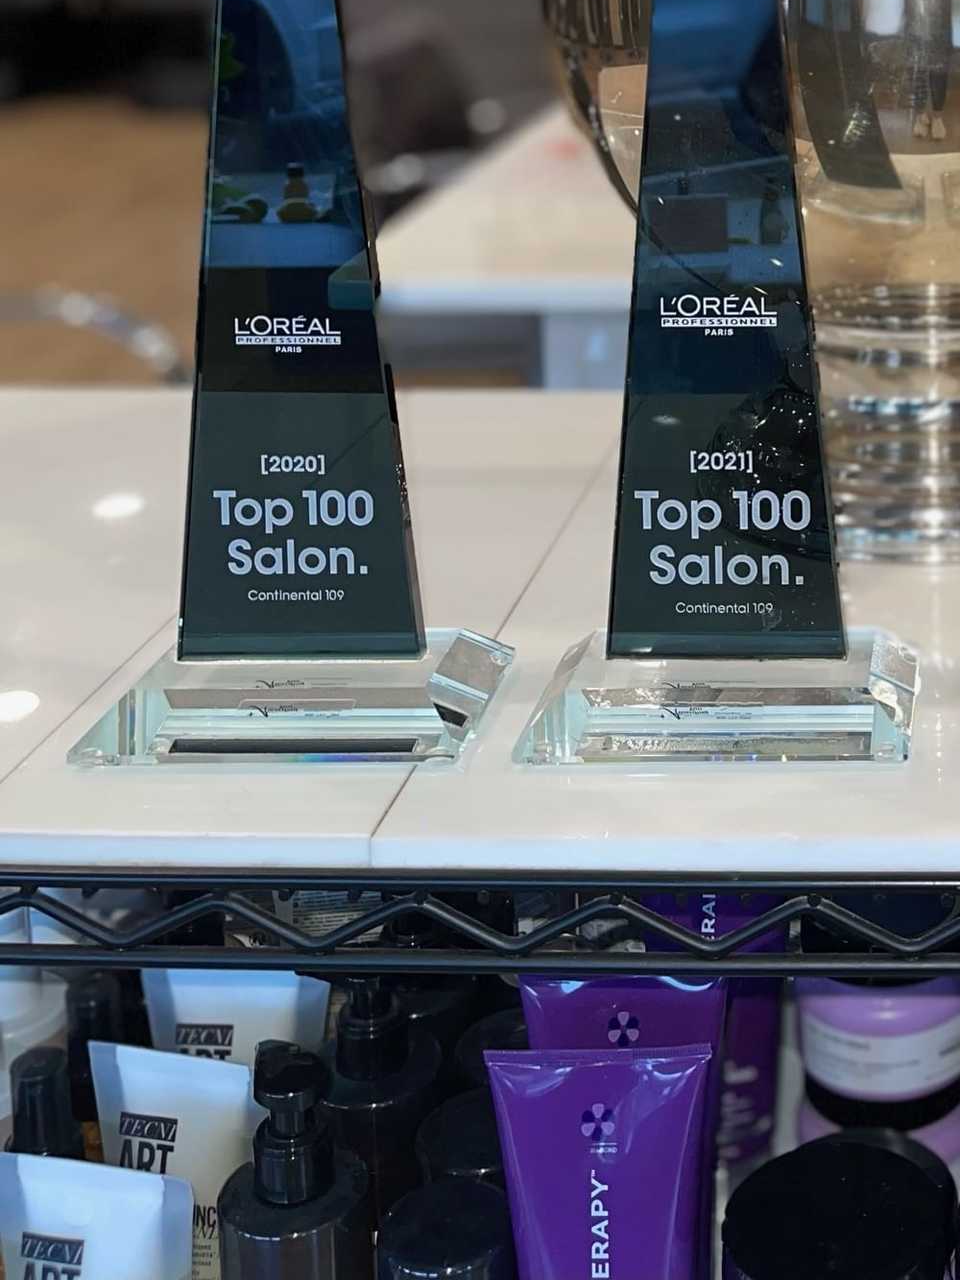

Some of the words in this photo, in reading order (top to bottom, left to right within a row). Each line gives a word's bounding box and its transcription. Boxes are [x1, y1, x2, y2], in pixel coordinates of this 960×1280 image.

[662, 318, 776, 326] PROFESSIONNEL
[237, 335, 340, 344] PROFESSIONNEL
[261, 455, 325, 474] [2020]
[690, 450, 752, 473] [2021]
[213, 490, 293, 533] Top
[302, 490, 373, 526] 100
[635, 491, 721, 539] Top
[733, 490, 810, 530] 100
[228, 539, 367, 574] Salon.
[650, 545, 803, 585] Salon.
[248, 590, 321, 600] Continental
[326, 590, 344, 600] 109
[676, 602, 749, 613] Continental
[753, 603, 773, 613] 109
[178, 1027, 233, 1045] TECNI
[121, 1118, 178, 1142] TECNI
[22, 1238, 84, 1265] TECNI
